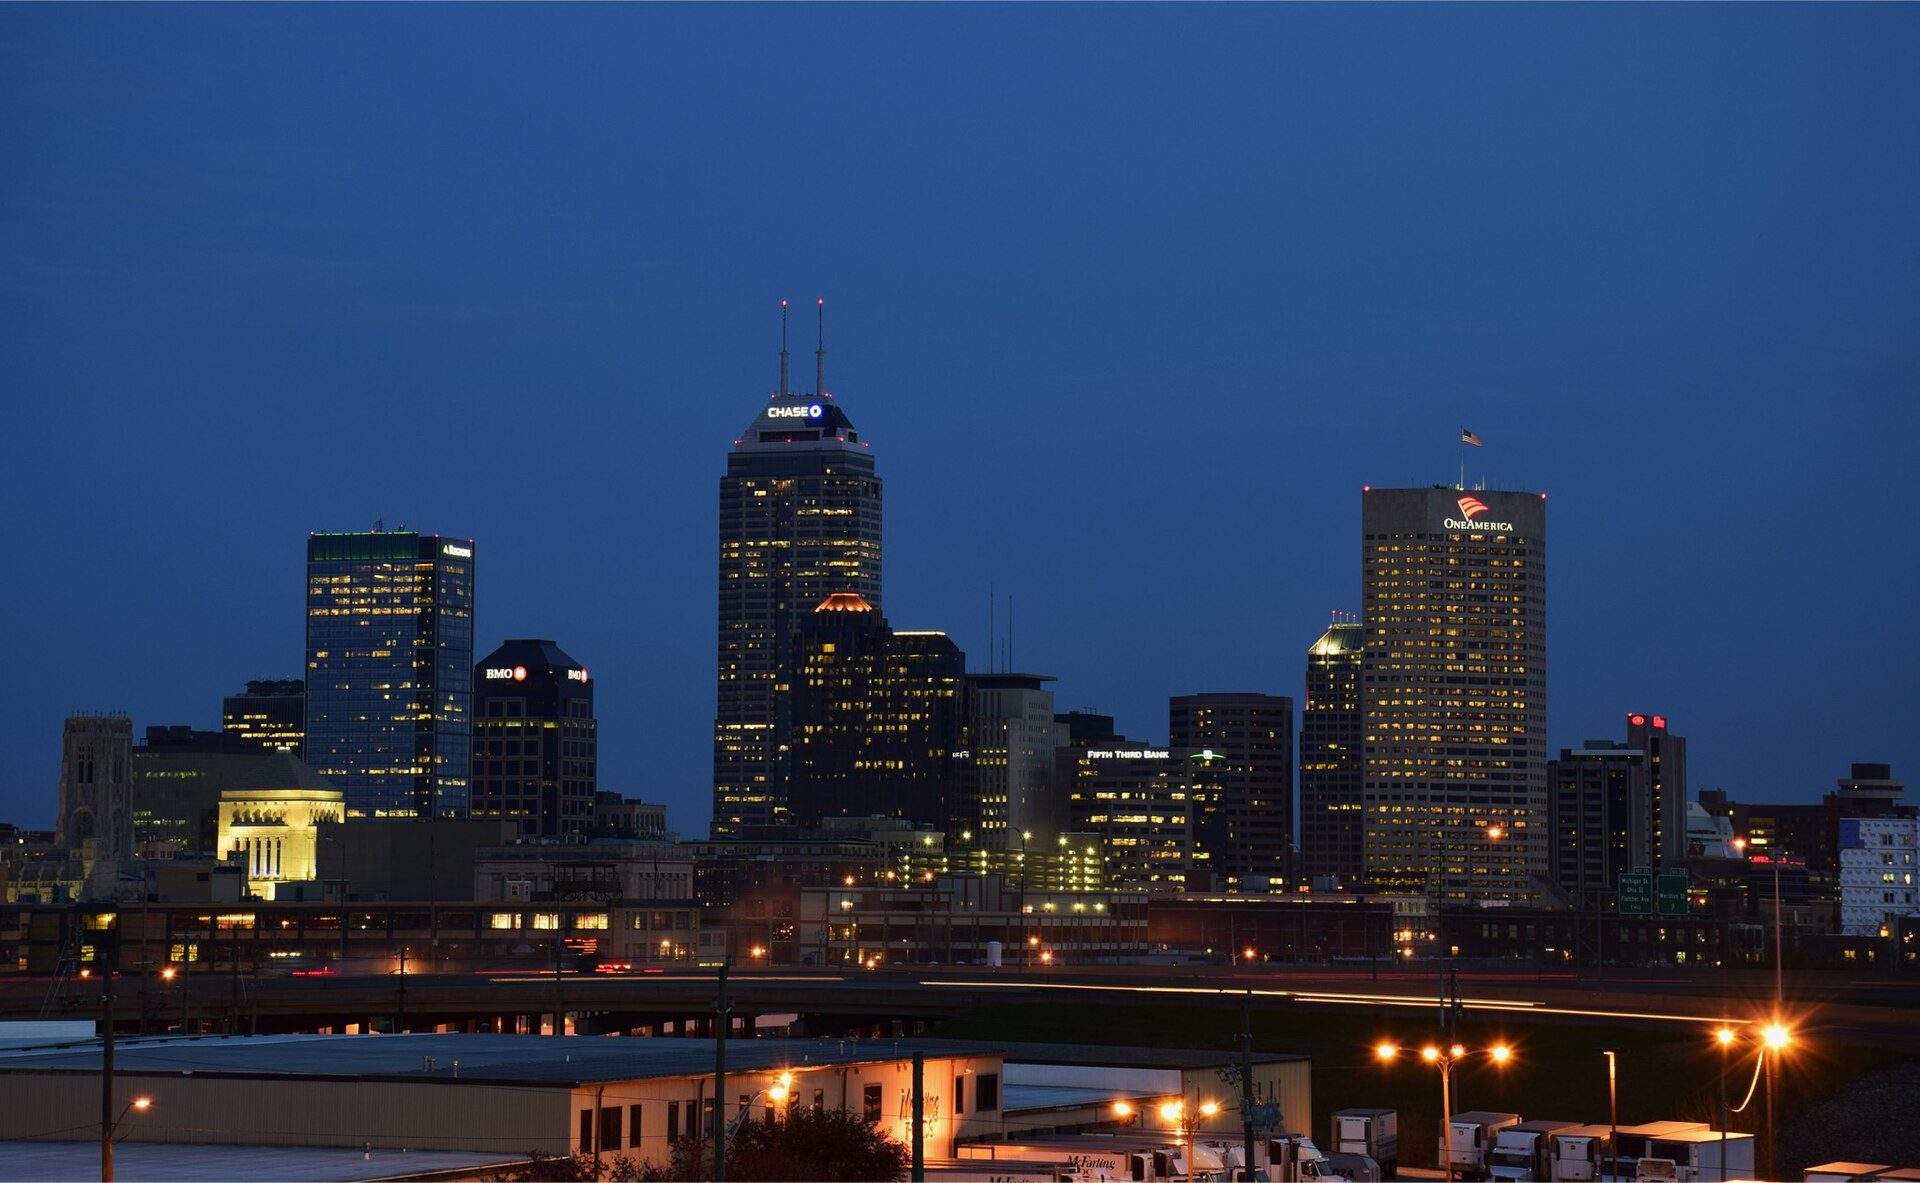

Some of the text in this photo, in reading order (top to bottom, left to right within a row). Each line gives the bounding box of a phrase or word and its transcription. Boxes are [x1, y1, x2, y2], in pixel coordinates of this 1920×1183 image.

[768, 407, 808, 418] CHASE
[486, 669, 513, 679] BMO
[568, 669, 581, 680] BMO
[1088, 750, 1169, 759] FIFTH THIRD BANK
